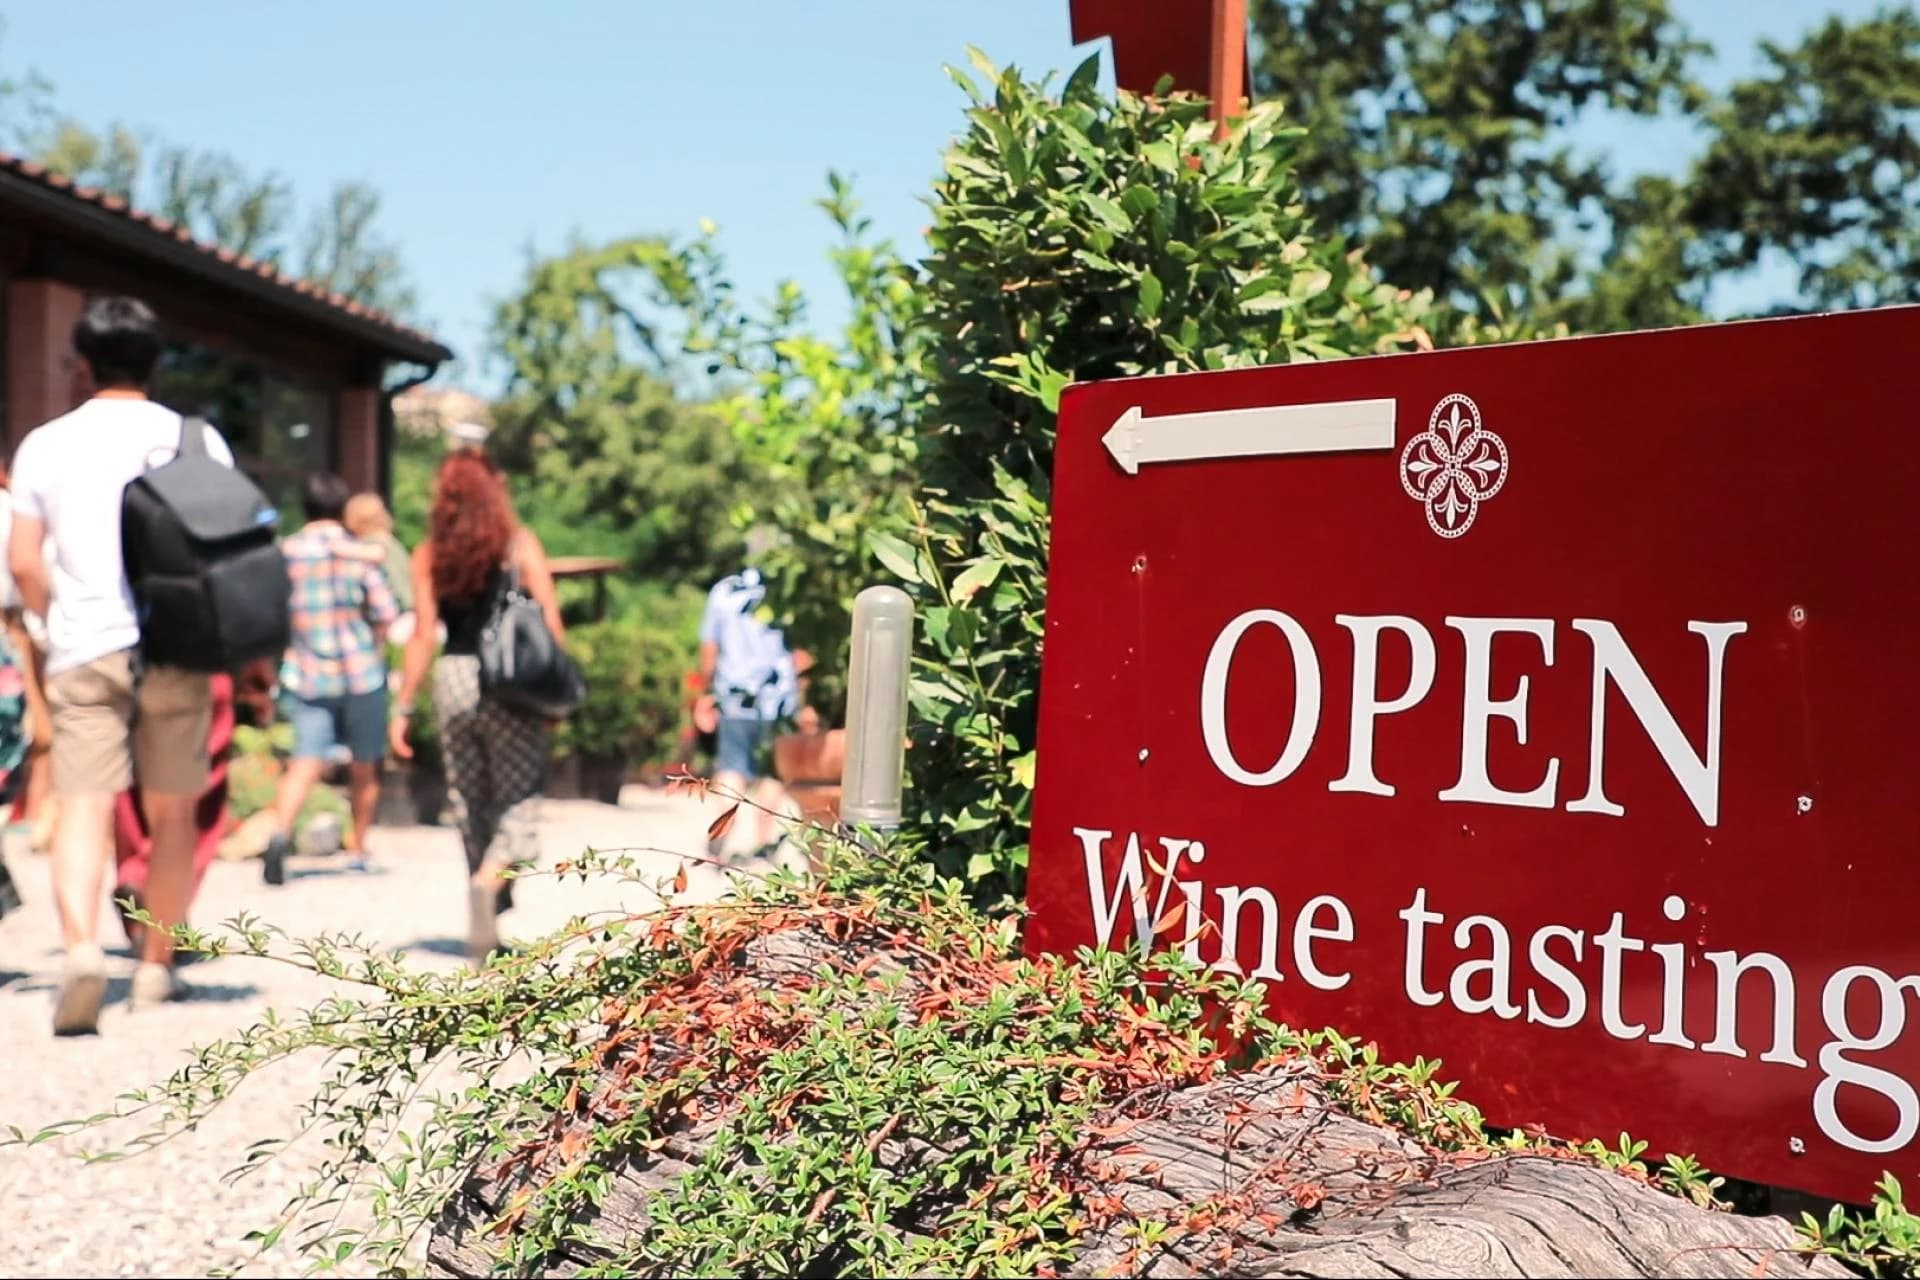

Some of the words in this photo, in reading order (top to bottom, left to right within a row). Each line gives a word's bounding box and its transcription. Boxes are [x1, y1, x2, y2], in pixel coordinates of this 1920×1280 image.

[1200, 609, 1748, 826] OPEN
[1073, 827, 1355, 991] Wine
[1400, 887, 1920, 1153] tasting
